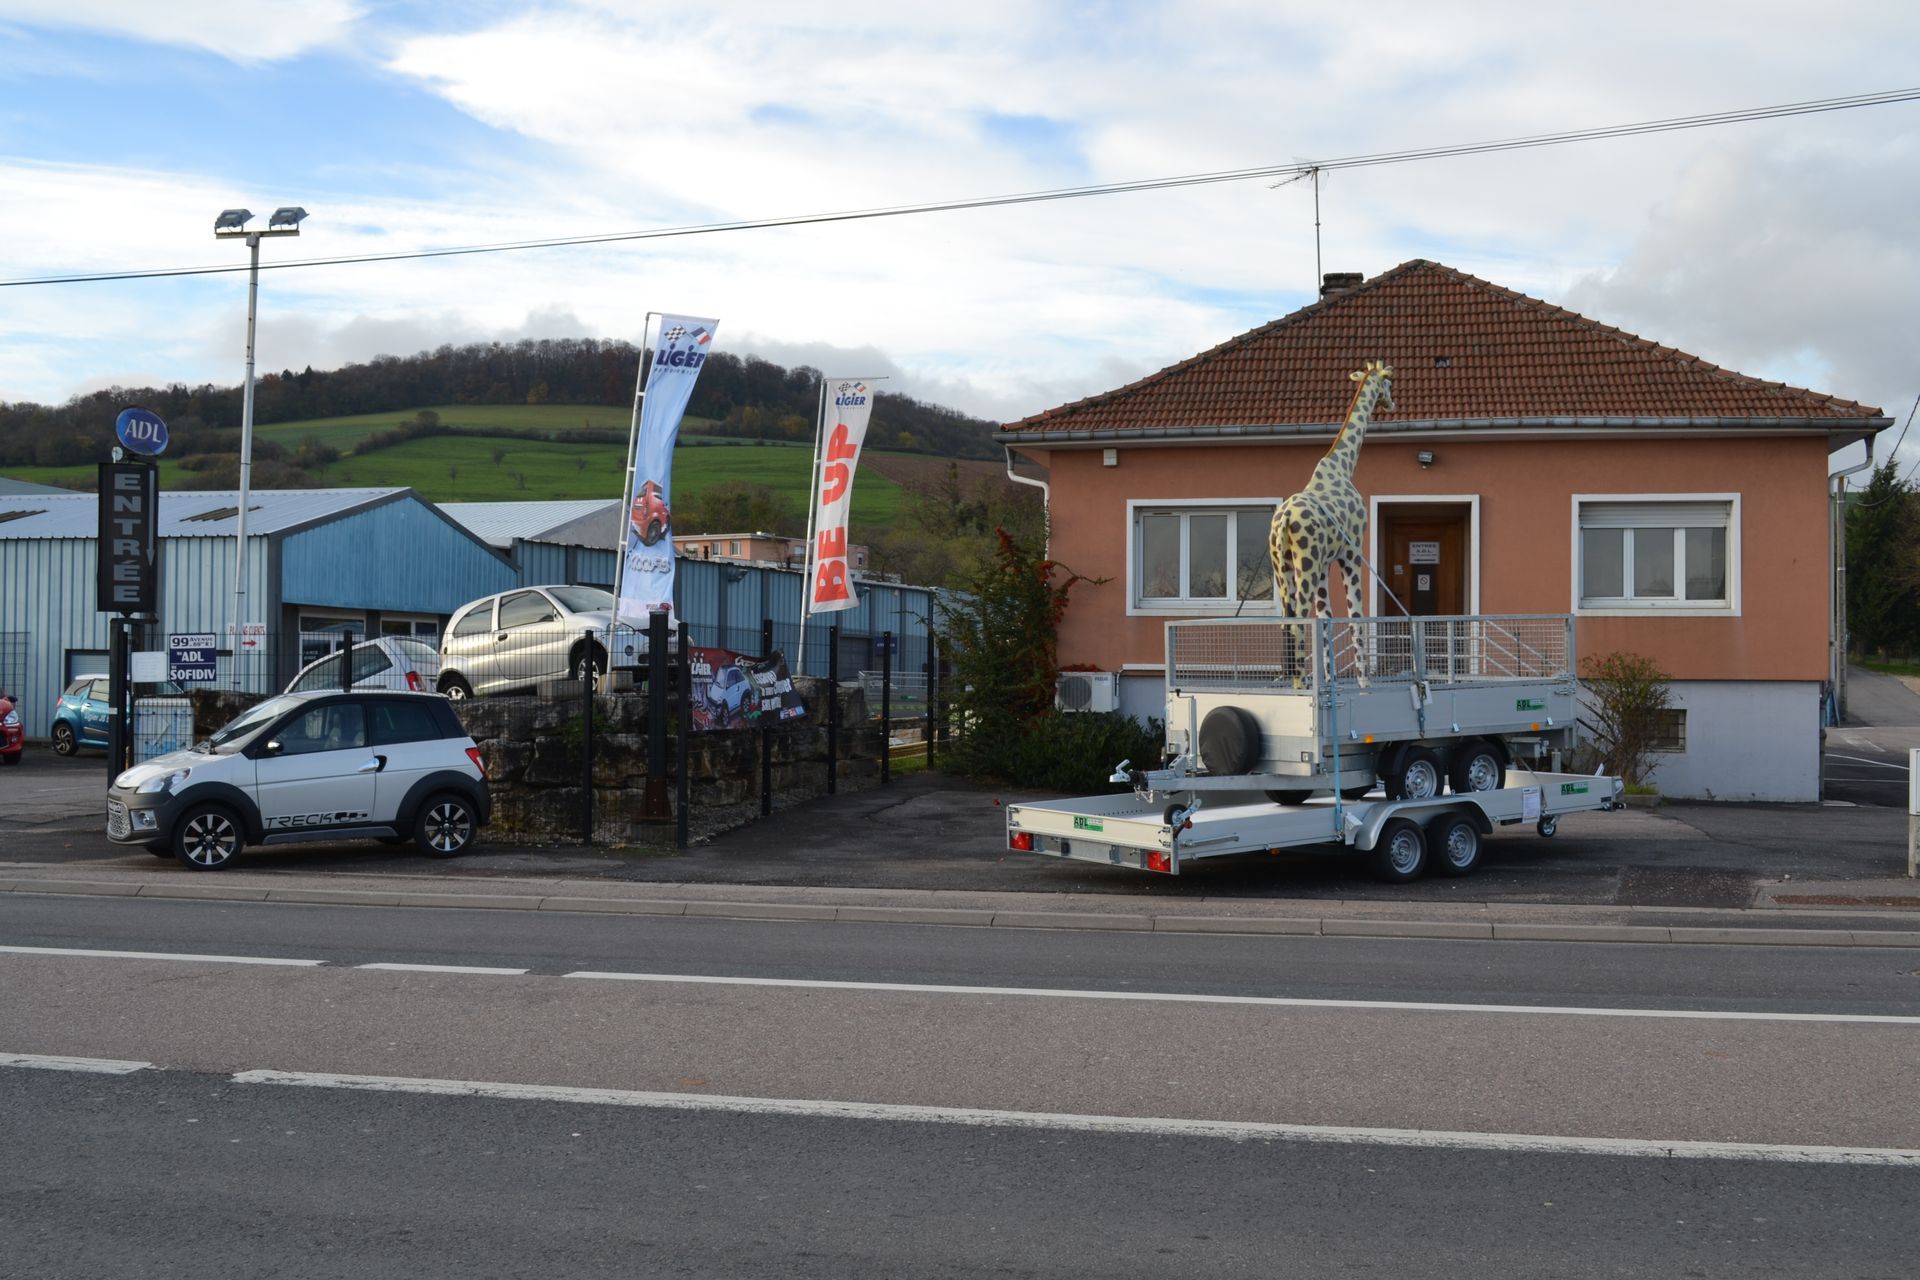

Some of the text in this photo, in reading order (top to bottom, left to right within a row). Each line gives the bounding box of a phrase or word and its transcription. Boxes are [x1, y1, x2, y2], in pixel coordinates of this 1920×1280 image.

[835, 392, 866, 406] LIGIER
[125, 418, 162, 443] ADL
[822, 423, 858, 506] UP
[113, 472, 142, 603] ENTRÉE
[814, 526, 850, 603] BE
[172, 637, 189, 647] 99
[181, 651, 205, 662] ADL
[170, 669, 216, 680] SOFIDIV
